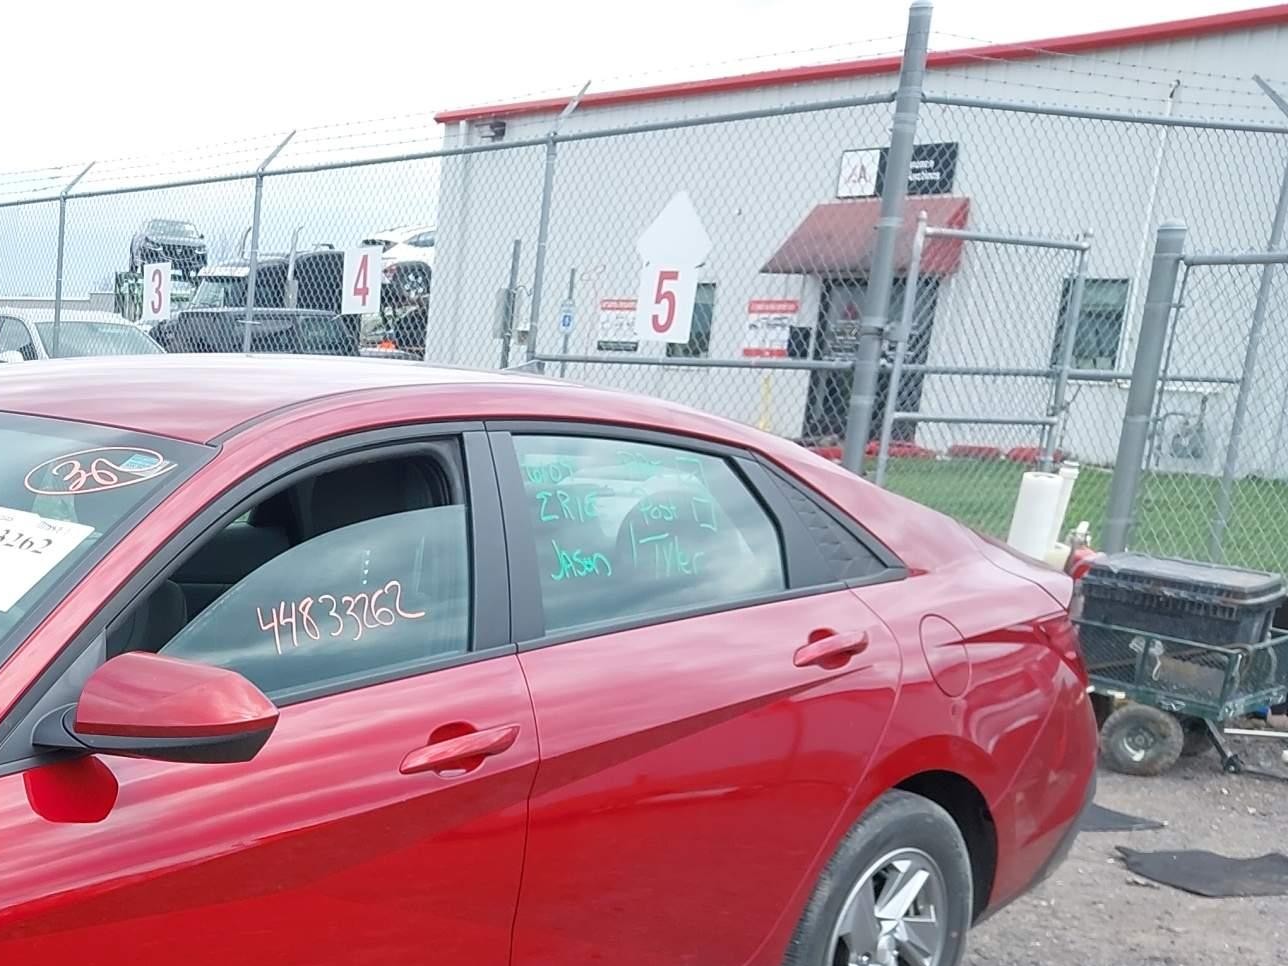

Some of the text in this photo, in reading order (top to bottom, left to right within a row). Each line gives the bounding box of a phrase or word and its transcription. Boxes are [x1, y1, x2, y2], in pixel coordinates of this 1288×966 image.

[150, 268, 163, 314] 3
[353, 254, 370, 306] 4
[651, 270, 679, 333] 5
[257, 580, 426, 655] 44833262
